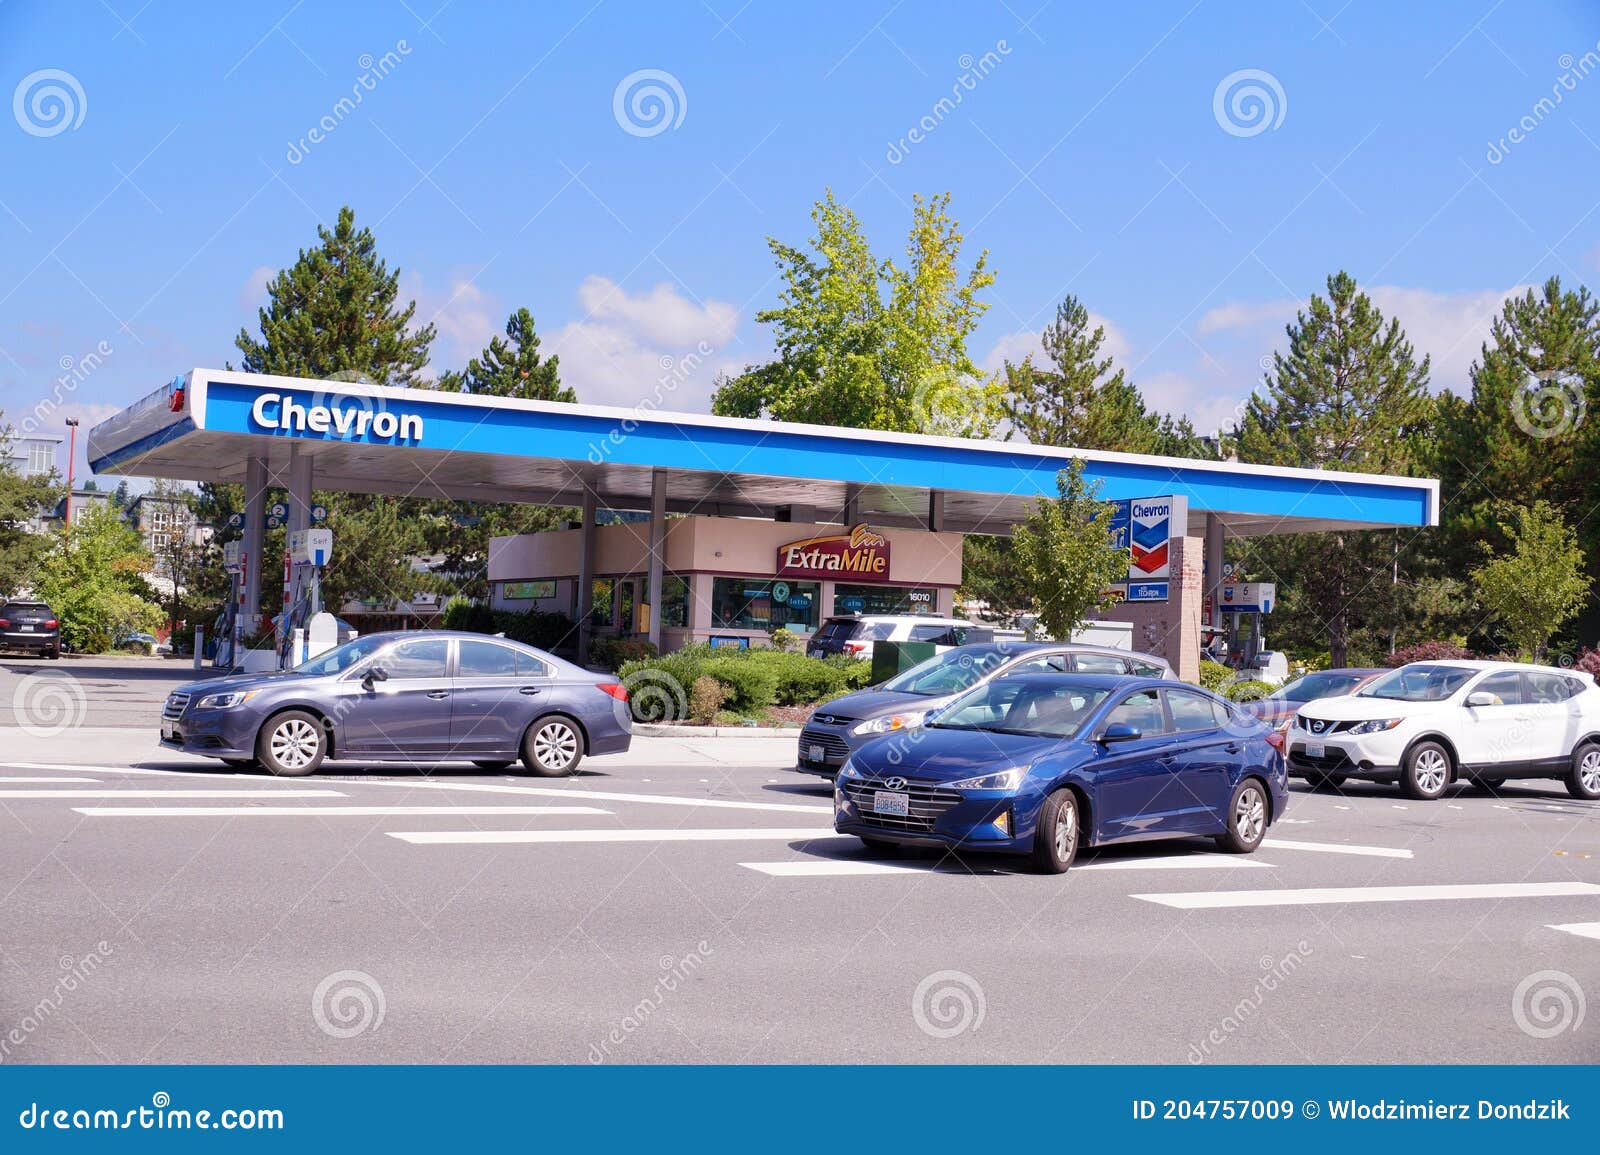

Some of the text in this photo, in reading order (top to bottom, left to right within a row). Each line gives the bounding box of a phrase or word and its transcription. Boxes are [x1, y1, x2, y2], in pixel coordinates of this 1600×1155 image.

[252, 393, 424, 440] Chevron
[275, 507, 282, 515] 2
[1133, 504, 1169, 518] Chevron
[785, 546, 886, 573] ExtraMile
[909, 592, 930, 602] 16010
[1243, 586, 1249, 596] 6
